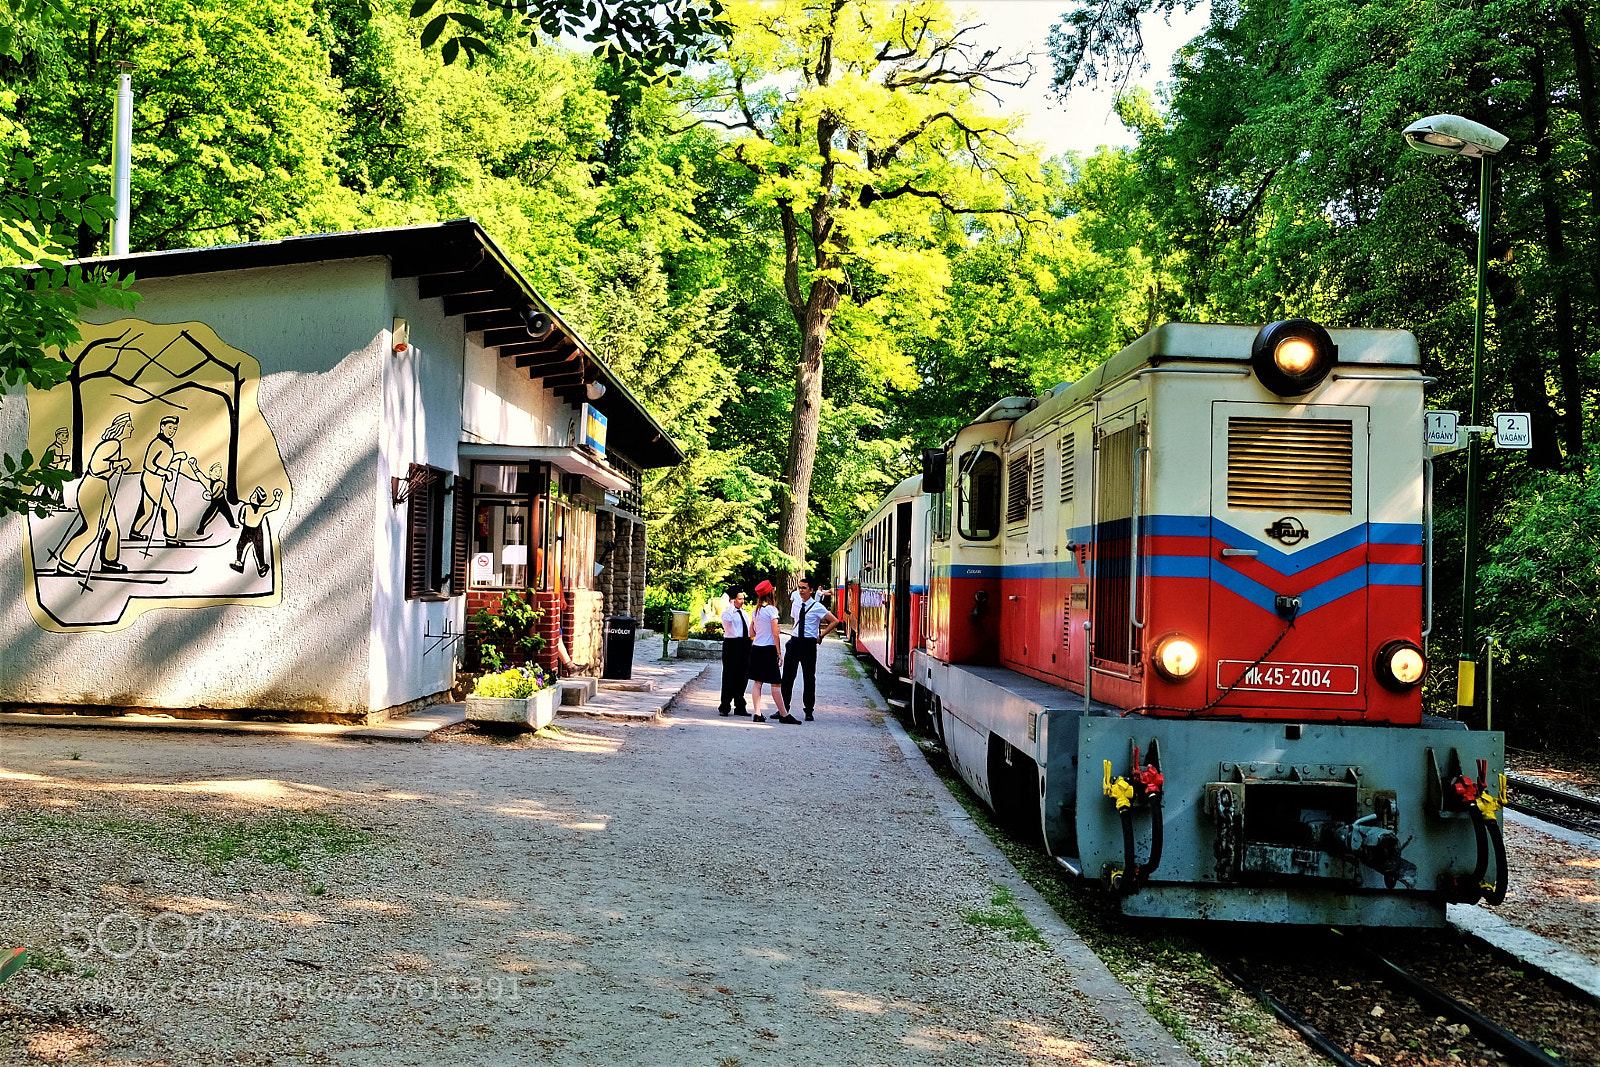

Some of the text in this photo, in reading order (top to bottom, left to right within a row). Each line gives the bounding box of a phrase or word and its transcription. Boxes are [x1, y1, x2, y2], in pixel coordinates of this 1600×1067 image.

[1435, 416, 1447, 428] 1.
[1507, 418, 1520, 430] 2.
[1500, 432, 1527, 442] VÁGÁNY
[1244, 666, 1331, 688] Mk45-2004
